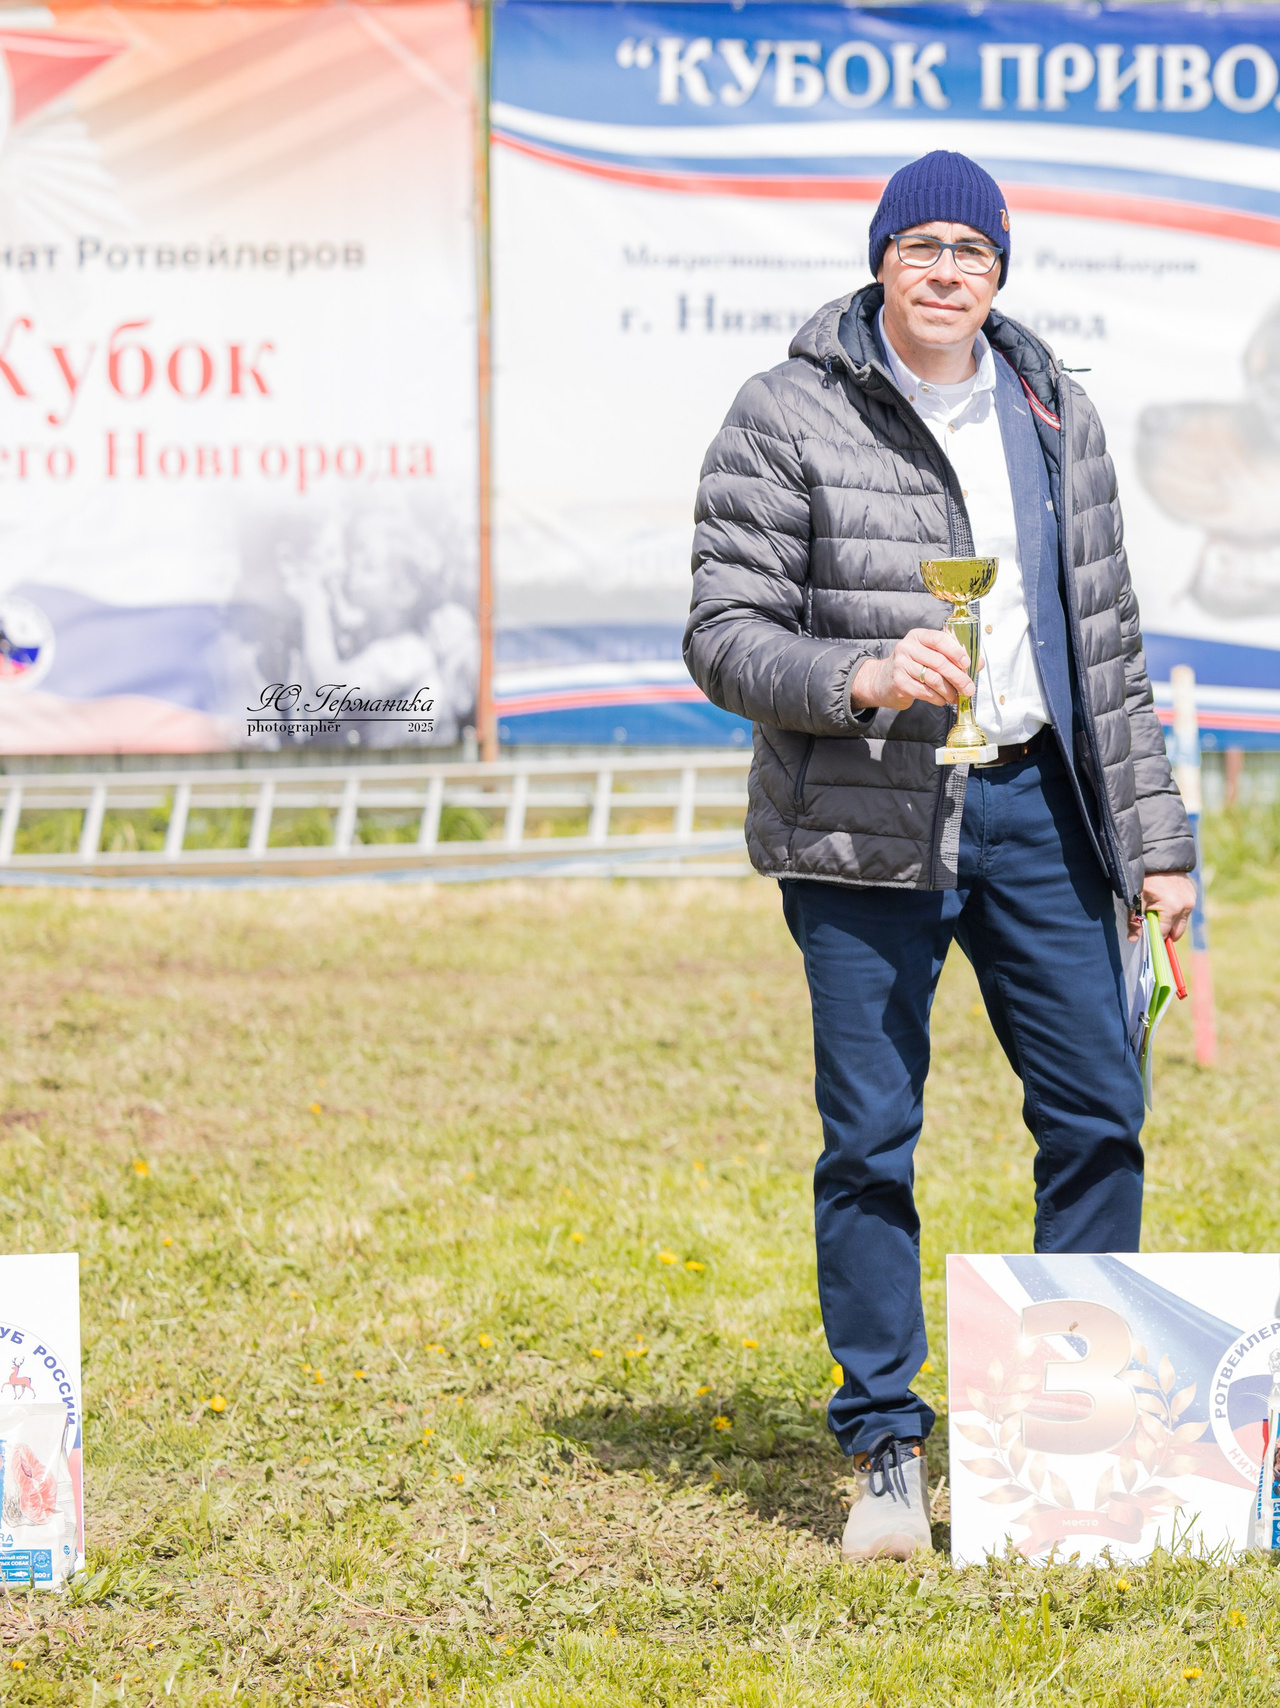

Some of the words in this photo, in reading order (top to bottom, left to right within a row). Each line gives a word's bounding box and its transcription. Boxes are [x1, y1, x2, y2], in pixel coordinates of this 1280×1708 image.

[77, 236, 364, 275] Ротвейлеров
[105, 429, 436, 494] Новгорода
[33, 1345, 76, 1425] РОССИИ
[1021, 1298, 1137, 1455] 3
